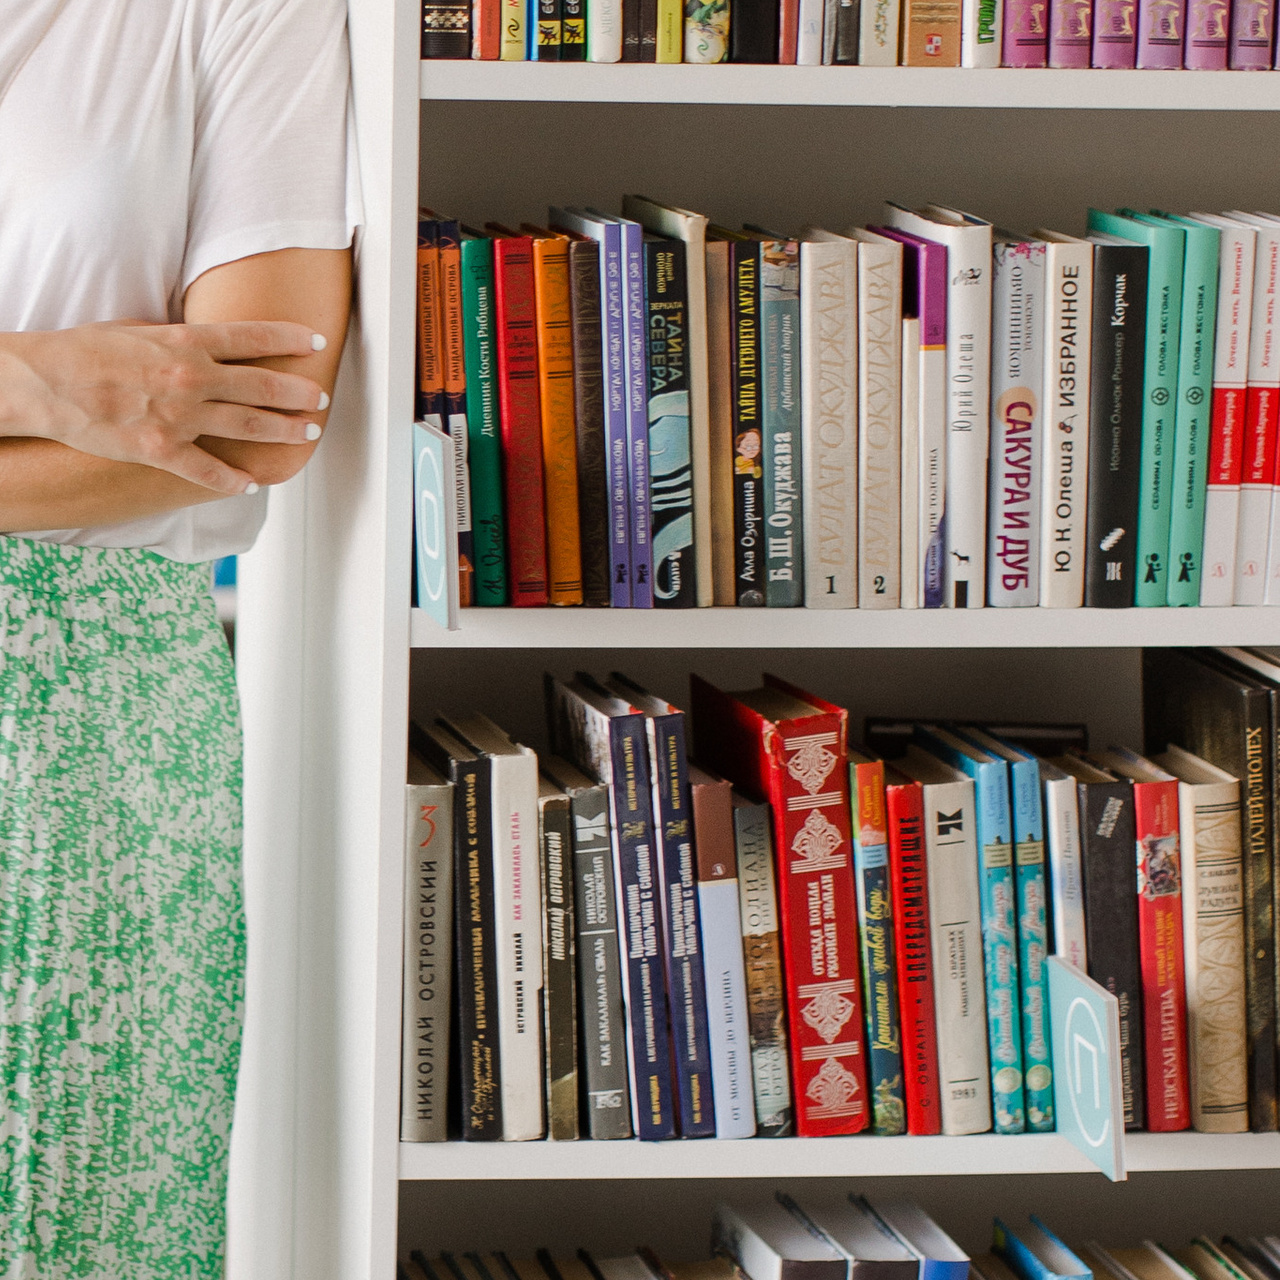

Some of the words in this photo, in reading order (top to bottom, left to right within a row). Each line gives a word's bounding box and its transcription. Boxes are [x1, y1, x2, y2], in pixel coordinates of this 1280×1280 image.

[475, 286, 489, 339] Рябцева
[738, 258, 755, 315] АМУЛЕТА
[666, 312, 683, 382] ТАЙНА
[739, 318, 756, 379] ДРЕВНЕГО
[781, 313, 793, 352] дворик
[1009, 266, 1023, 379] ОВЧИННИКОВ
[1059, 265, 1079, 407] ИЗБРАННОЕ
[478, 339, 490, 379] Кости
[650, 315, 668, 392] СЕВЕРА
[781, 352, 793, 411] Арбатский
[819, 259, 849, 449] ОКУДЖАВА
[866, 260, 897, 451] ОКУДЖАВА
[953, 333, 975, 383] Олеша
[479, 381, 495, 438] Дневник
[739, 382, 756, 422] ТАЙНА
[951, 390, 977, 432] Юрий
[768, 431, 797, 528] Окуджава
[1003, 401, 1033, 505] САКУРА
[1056, 440, 1074, 519] Олеша
[741, 480, 761, 547] Озорнина
[816, 455, 845, 566] БУЛАТ
[864, 456, 890, 568] БУЛАТ
[1003, 511, 1030, 529] И
[741, 549, 755, 582] Алла
[768, 530, 793, 560] Ш.
[769, 562, 793, 582] Б.
[996, 535, 1030, 591] ДУБ
[825, 575, 837, 595] 1
[874, 576, 886, 594] 2
[510, 811, 521, 840] СТАЛЬ
[511, 844, 522, 901] ЗАКАЛЯЛАСЬ
[545, 831, 564, 904] ОСТРОВСКИЙ
[513, 904, 523, 920] КАК
[900, 816, 927, 983] ВПЕРЕДСМОТРЯЩИЕ
[419, 860, 438, 1001] ОСТРОВСКИЙ
[513, 932, 523, 972] НИКОЛАЙ
[548, 907, 565, 961] НИКОЛАЙ
[514, 980, 525, 1034] ОСТРОВСКИЙ
[722, 970, 734, 1027] БЕРЛИНА
[1160, 988, 1177, 1042] БИТВА
[726, 1031, 735, 1045] ДО
[914, 1020, 929, 1084] ОБРАНТ
[417, 1017, 434, 1120] НИКОЛАЙ
[726, 1050, 739, 1100] МОСКВЫ
[1074, 1033, 1100, 1109] П
[1163, 1046, 1180, 1120] НЕВСКАЯ
[730, 1107, 740, 1120] ОТ
